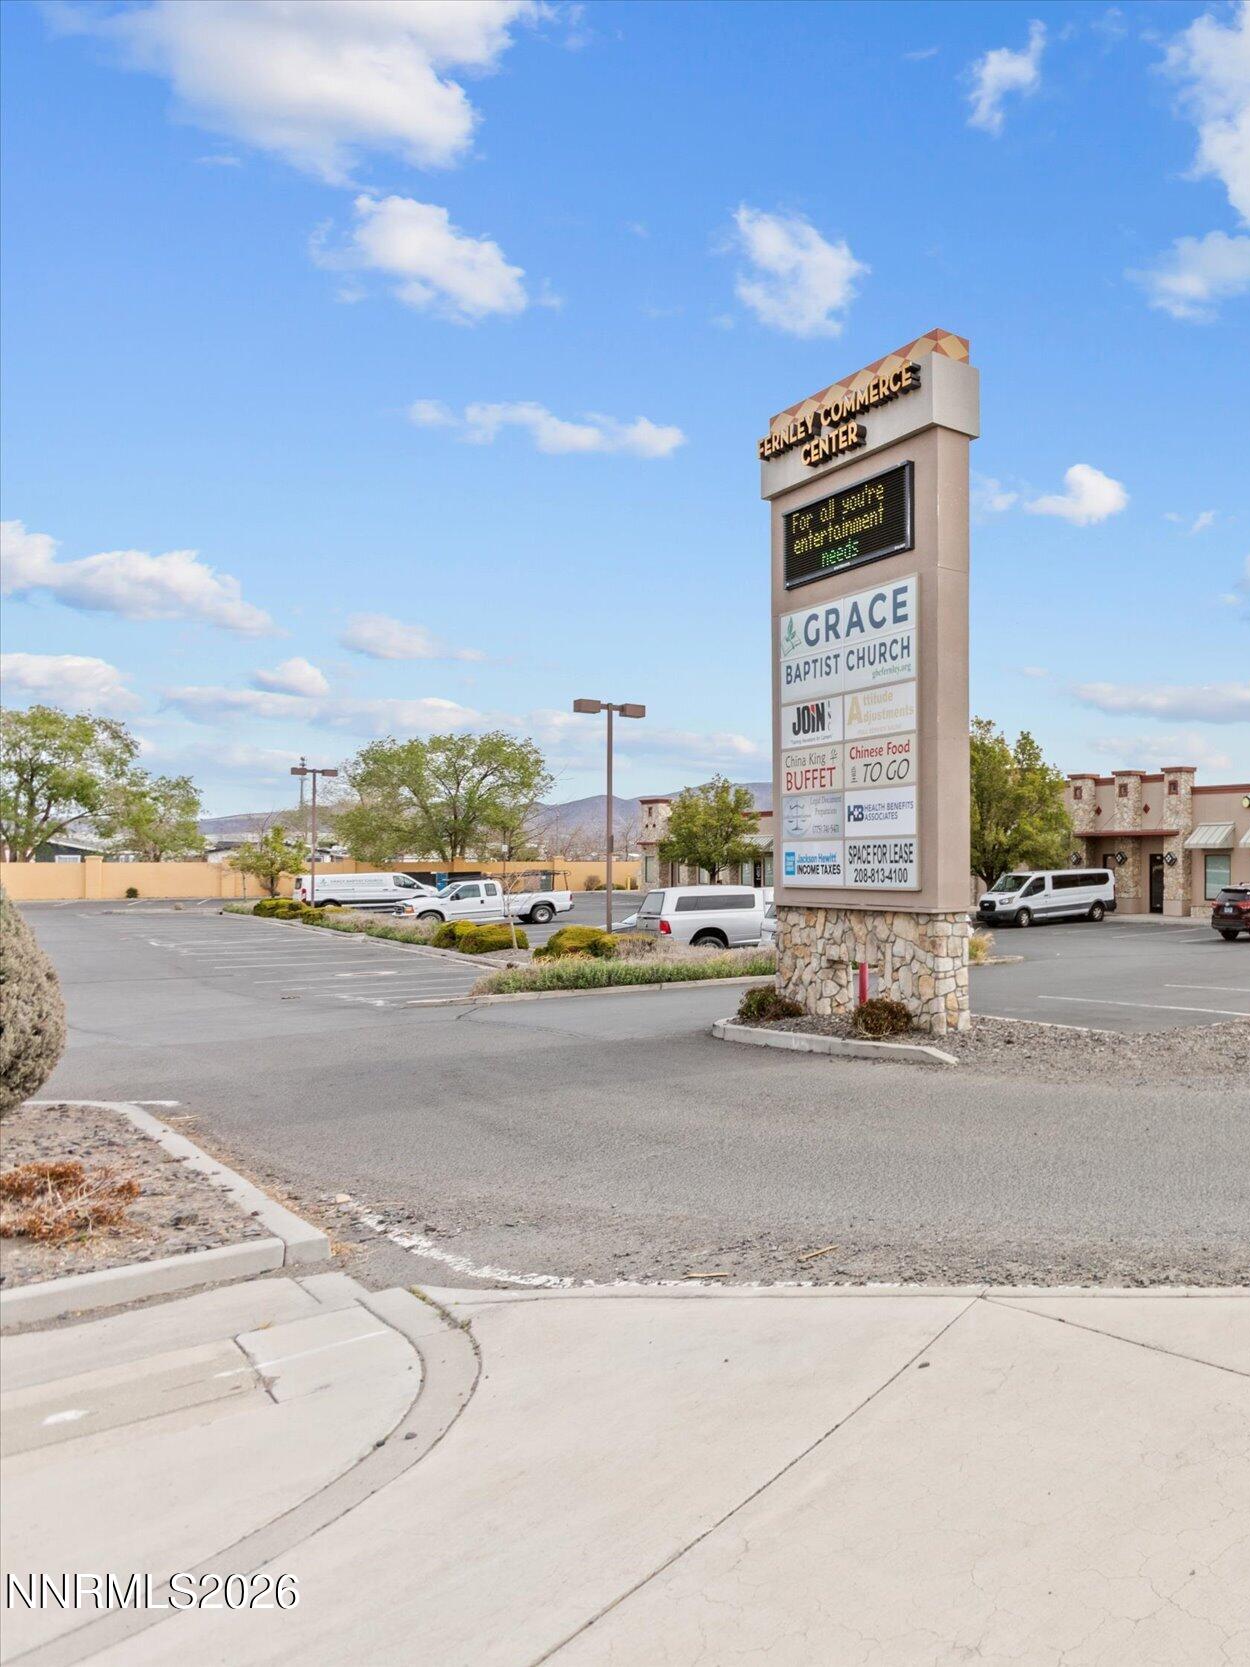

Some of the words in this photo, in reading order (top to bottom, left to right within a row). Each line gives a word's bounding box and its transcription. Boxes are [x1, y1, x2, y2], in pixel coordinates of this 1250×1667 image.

[759, 413, 818, 460] FERNLEY
[820, 361, 917, 427] COMMERCE
[800, 421, 863, 467] CENTER
[792, 512, 813, 534] For
[820, 498, 835, 523] all
[841, 484, 884, 515] you're
[794, 502, 884, 555] entertainment
[821, 538, 859, 568] needs
[804, 585, 909, 647] GRACE
[785, 653, 841, 686] BAPTIST
[845, 635, 911, 672] CHURCH
[785, 755, 806, 769] China
[809, 752, 826, 767] King
[849, 745, 884, 760] Chinese
[886, 739, 910, 756] Food
[786, 766, 836, 791] BUFFET
[863, 761, 883, 783] TO
[886, 758, 910, 781] GO
[864, 803, 886, 812] HEALTH
[886, 800, 914, 811] BENEFITS
[864, 811, 898, 822] ASSOCIATES
[848, 844, 871, 865] SPACE
[872, 843, 888, 865] FOR
[889, 842, 914, 864] LEASE
[797, 864, 820, 876] INCOME
[820, 863, 841, 876] TAXES
[853, 867, 908, 883] 208-813-4100
